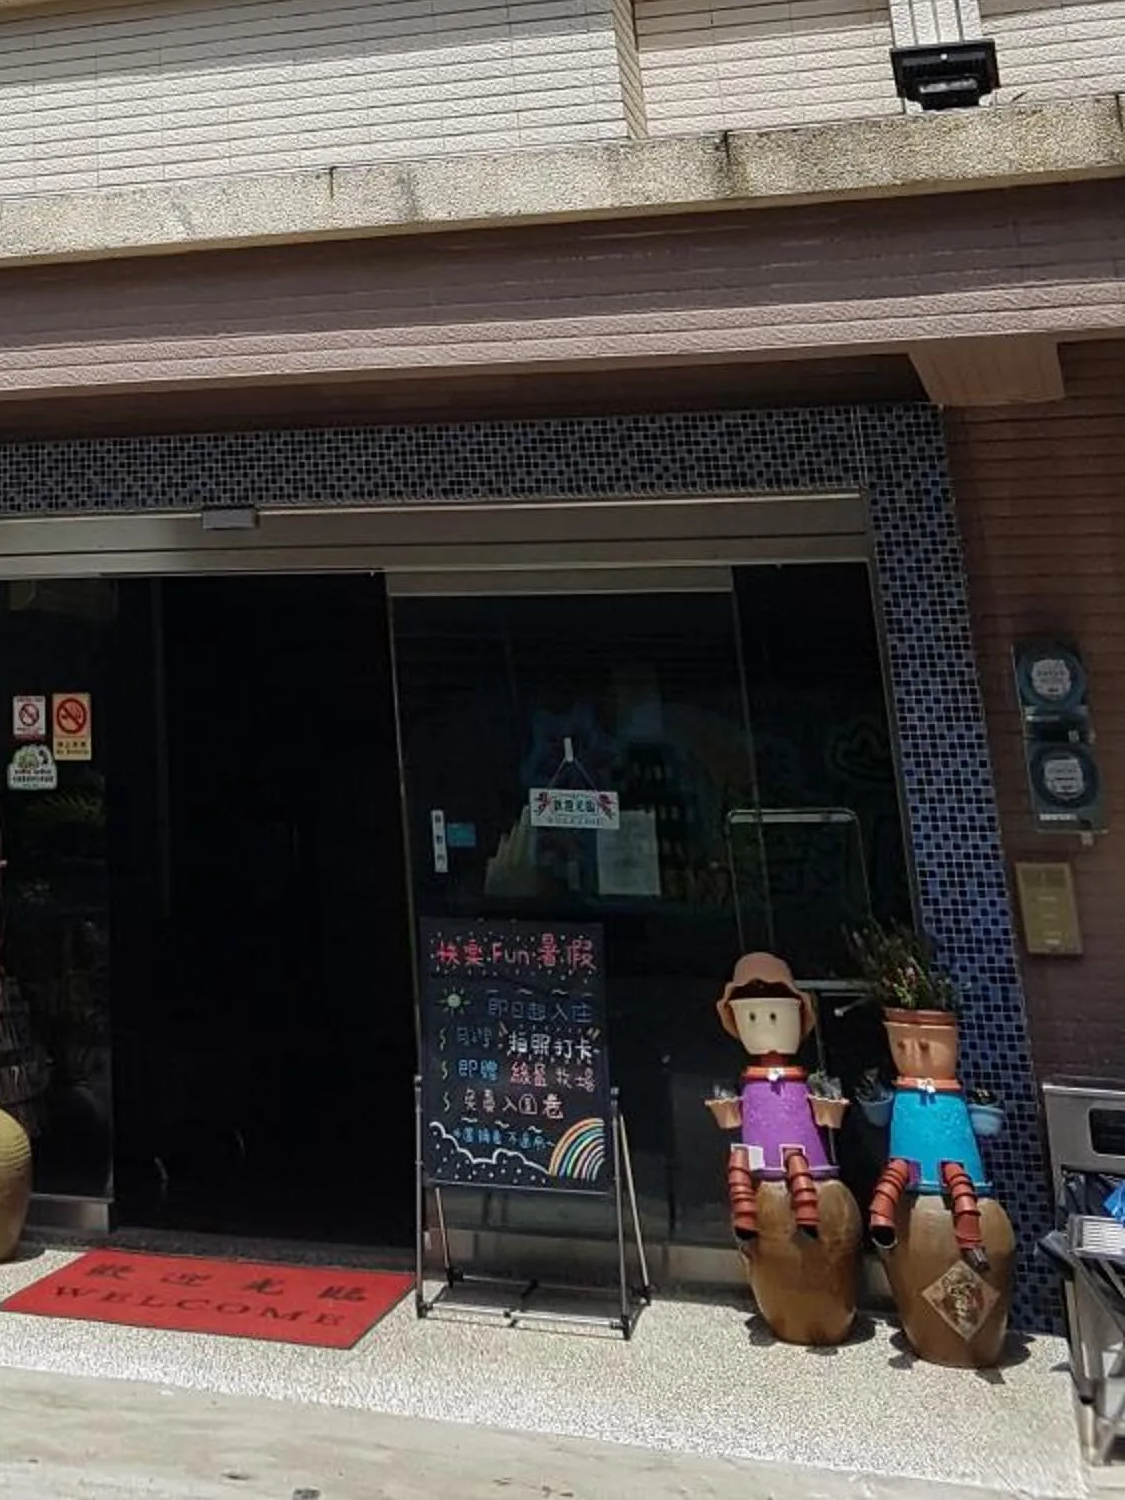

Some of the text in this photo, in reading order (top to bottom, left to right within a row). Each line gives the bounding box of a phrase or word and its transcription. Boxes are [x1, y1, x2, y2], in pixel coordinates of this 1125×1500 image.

[86, 1263, 368, 1303] 歡迎光臨
[53, 1285, 346, 1326] WELCOME
